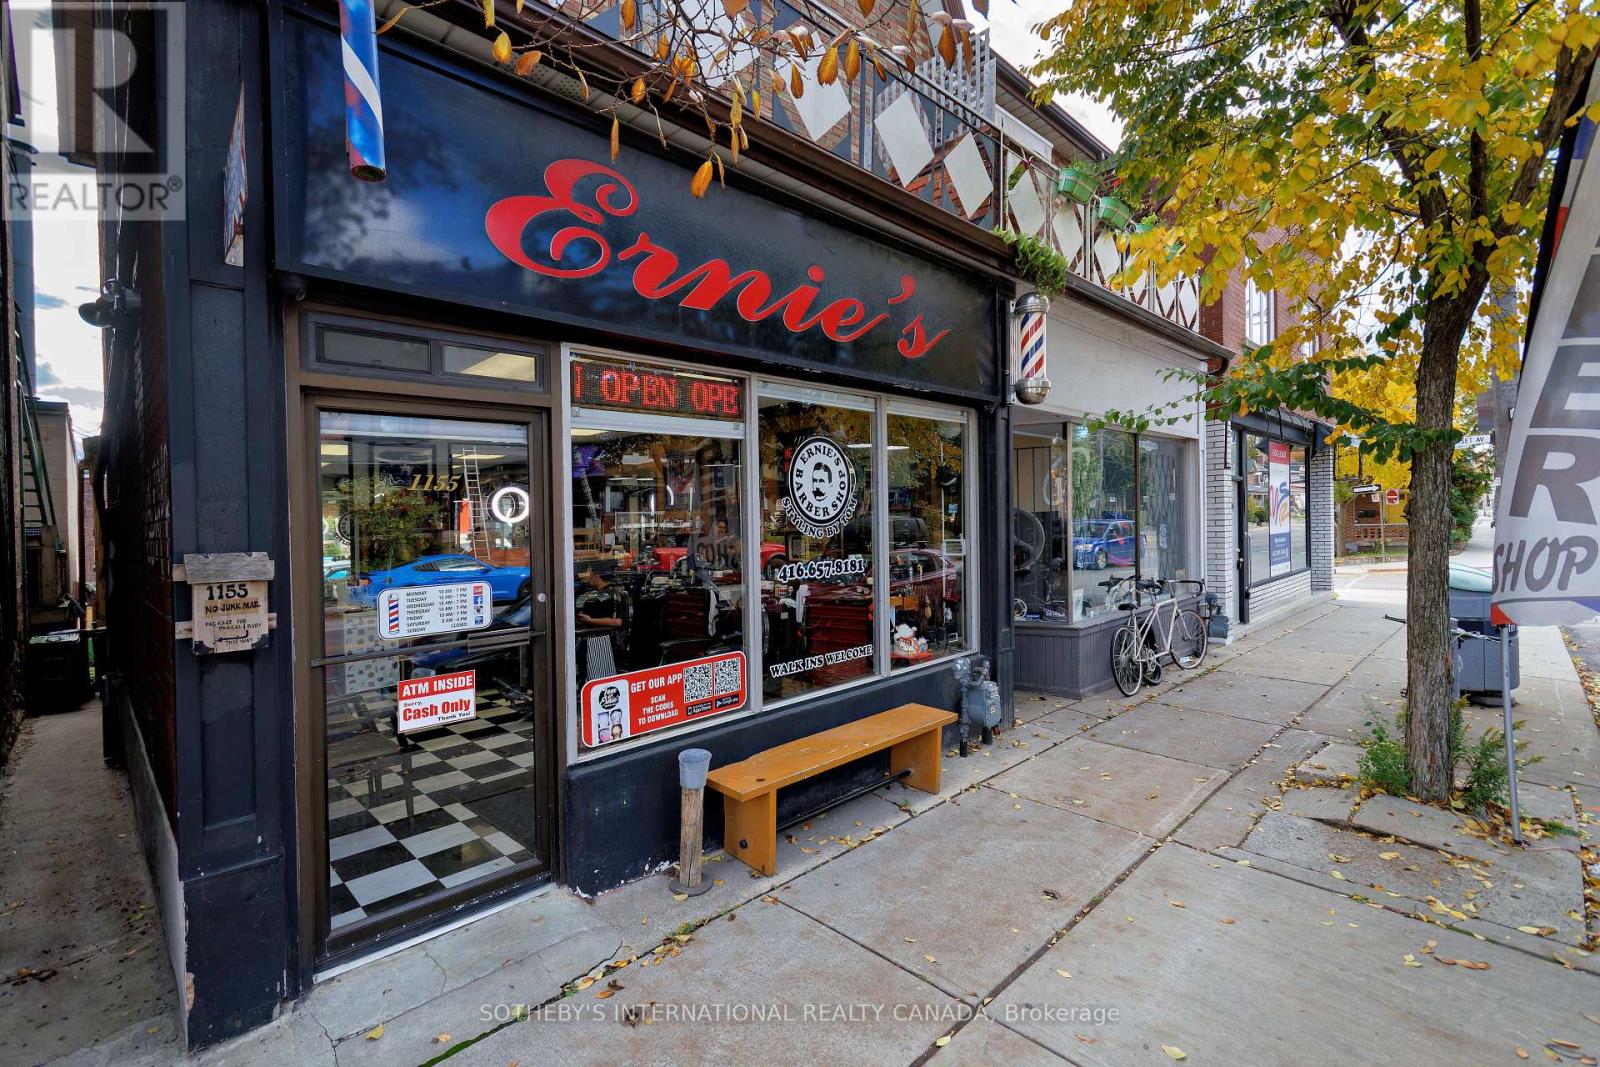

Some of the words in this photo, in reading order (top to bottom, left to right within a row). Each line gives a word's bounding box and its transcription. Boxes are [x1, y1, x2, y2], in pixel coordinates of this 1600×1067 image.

[485, 159, 951, 359] Ernie's
[601, 367, 677, 408] OPEN
[800, 445, 842, 467] ERNIE'S
[407, 474, 462, 492] 1155
[795, 468, 831, 518] BARBER
[831, 470, 847, 512] SHOP
[782, 497, 824, 539] STYLING
[826, 522, 841, 538] BY
[840, 498, 858, 526] TOM
[779, 558, 865, 583] 416.657.8181
[206, 583, 249, 600] 1155
[205, 604, 218, 615] NO
[221, 602, 241, 612] JUNK
[406, 620, 431, 628] SATURDAY
[770, 659, 804, 678] WALK
[804, 654, 824, 670] INS
[825, 644, 874, 665] WELCOME
[402, 681, 430, 697] ATM
[433, 675, 473, 691] INSIDE
[631, 679, 647, 693] GET
[648, 676, 665, 689] OUR
[667, 673, 682, 686] APP
[402, 703, 438, 721] Cash
[441, 698, 471, 714] Only
[642, 705, 654, 715] THE
[655, 701, 674, 712] CODES
[650, 694, 666, 704] SCAN
[638, 716, 646, 725] TO
[647, 709, 679, 724] DOWNLOAD
